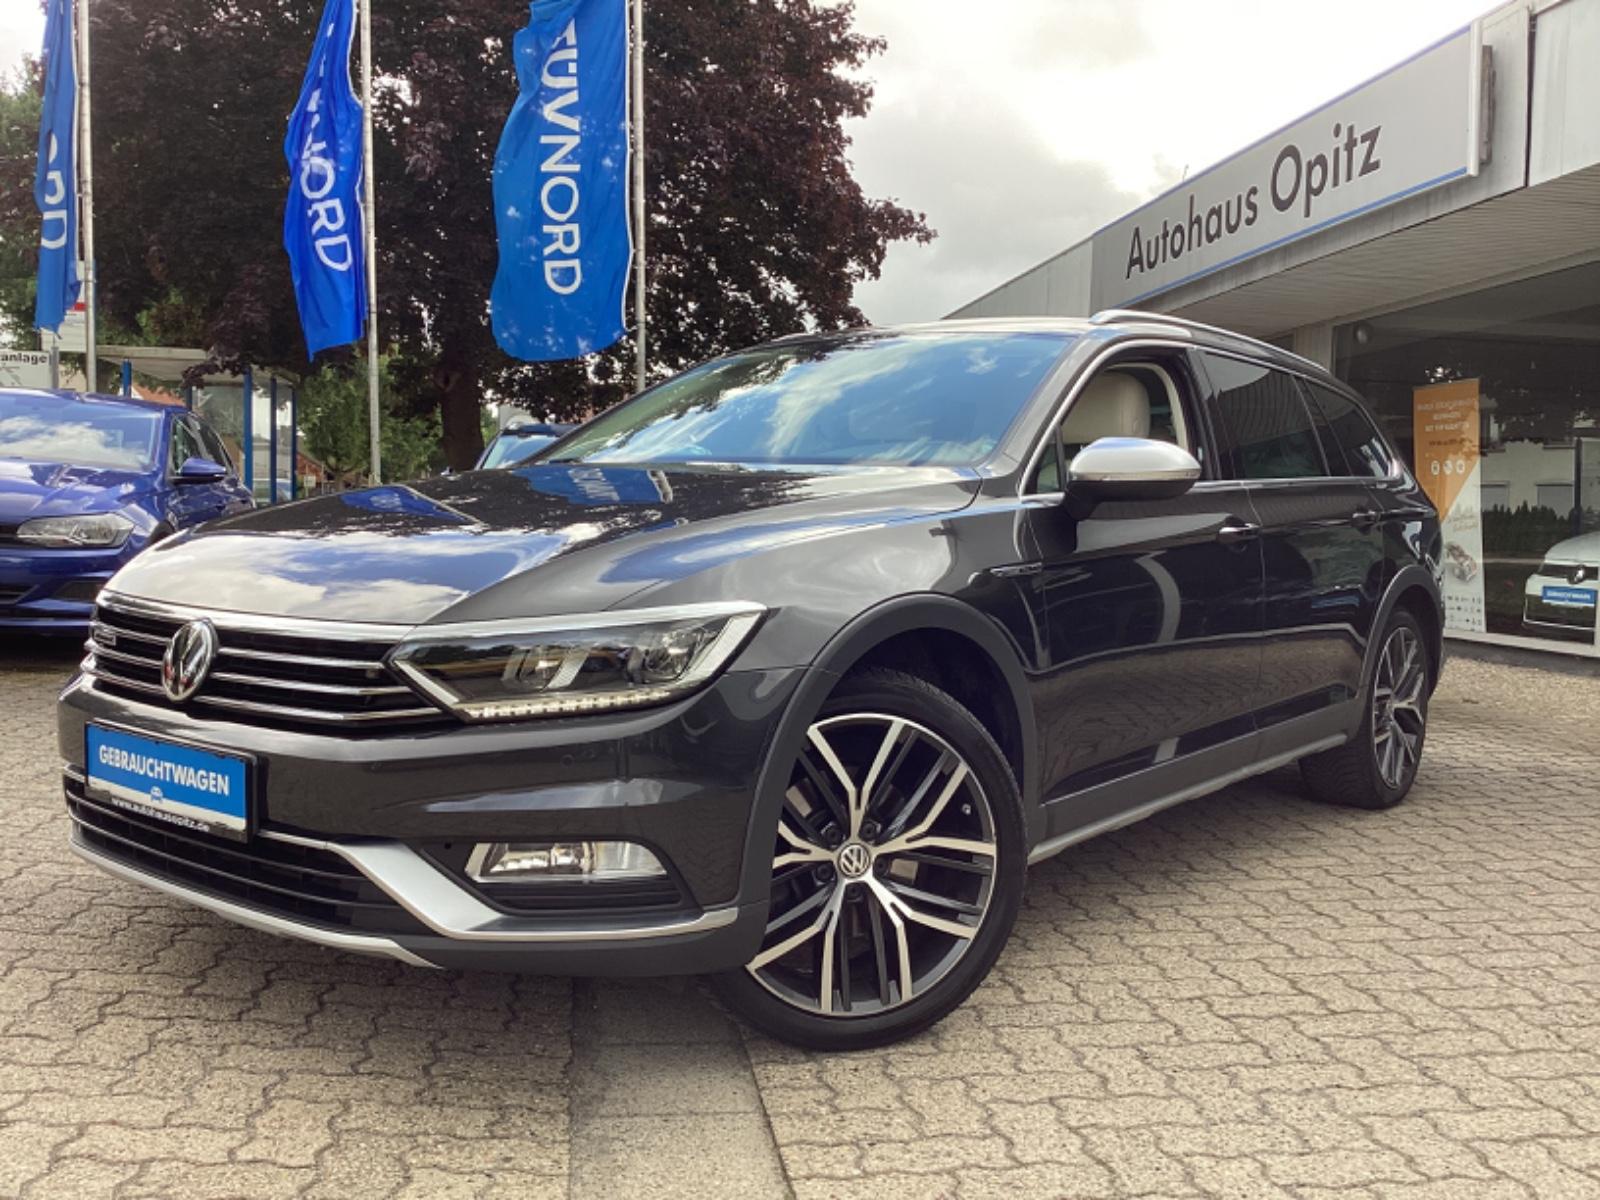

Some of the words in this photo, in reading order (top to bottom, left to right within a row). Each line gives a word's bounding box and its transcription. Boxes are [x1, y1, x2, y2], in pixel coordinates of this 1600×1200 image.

[1125, 185, 1259, 280] Autohaus
[1270, 122, 1382, 218] Opitz
[98, 744, 230, 796] GEBRAUCHTWAGEN
